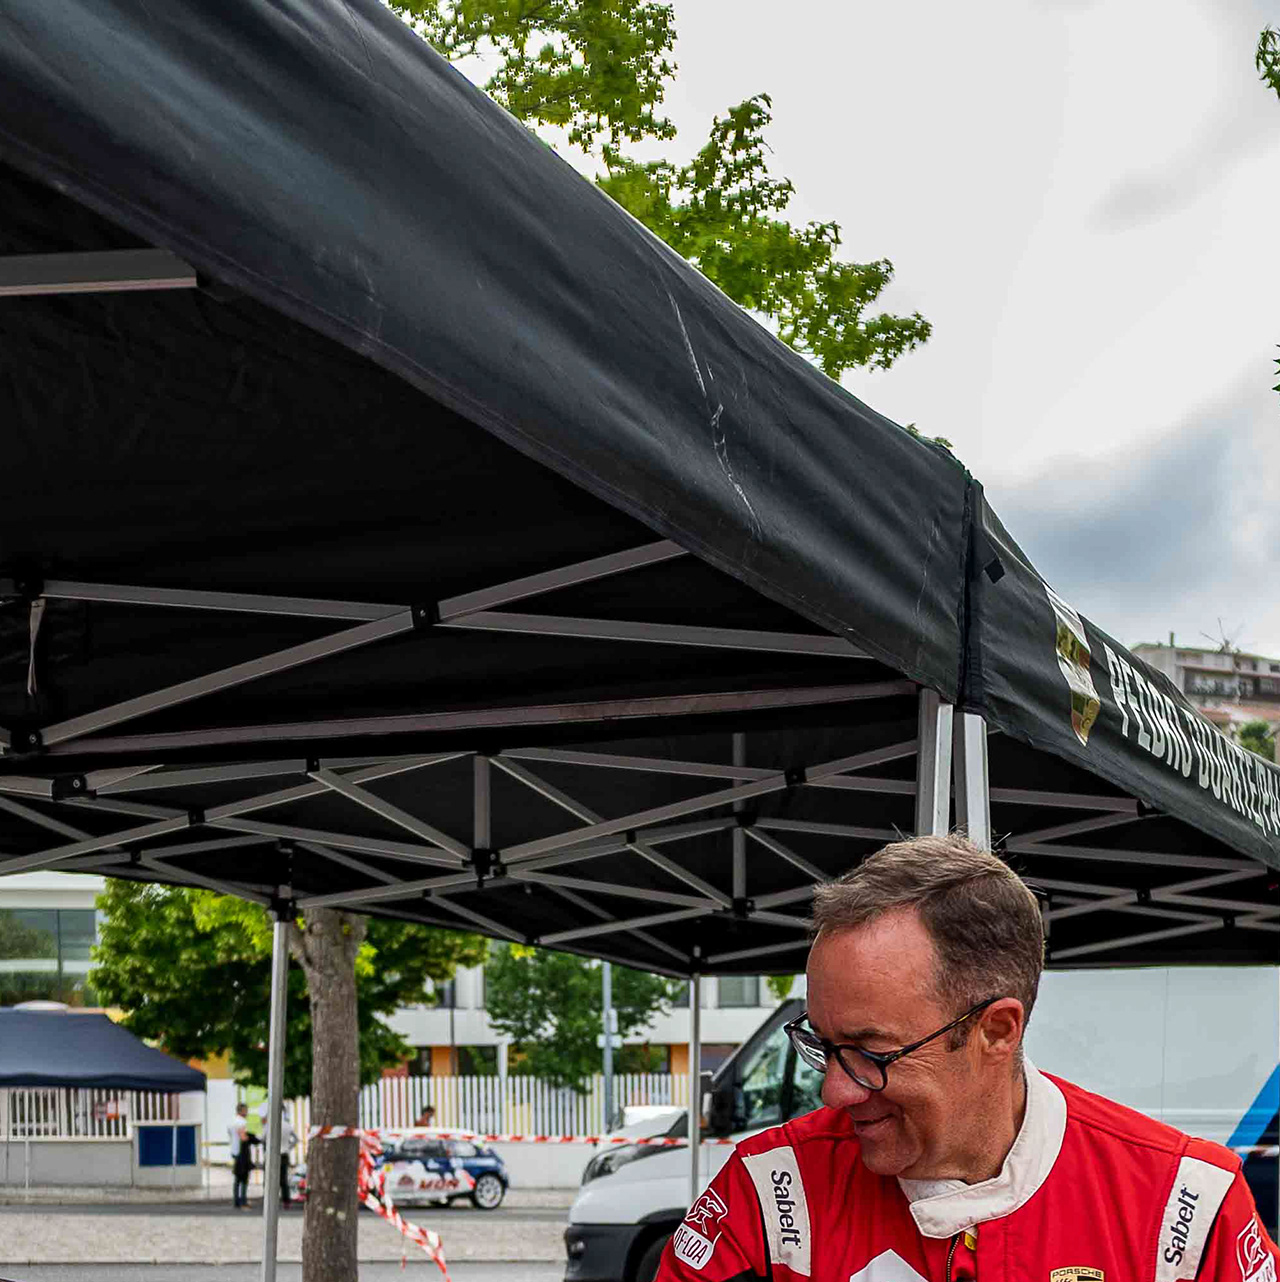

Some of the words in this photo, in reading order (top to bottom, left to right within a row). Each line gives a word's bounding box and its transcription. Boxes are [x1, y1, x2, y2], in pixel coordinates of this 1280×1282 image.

[1102, 642, 1193, 778] PEDRO
[771, 1170, 801, 1246] Sabelt
[1163, 1186, 1199, 1266] Sabelt
[1052, 1267, 1102, 1278] PORSCHE
